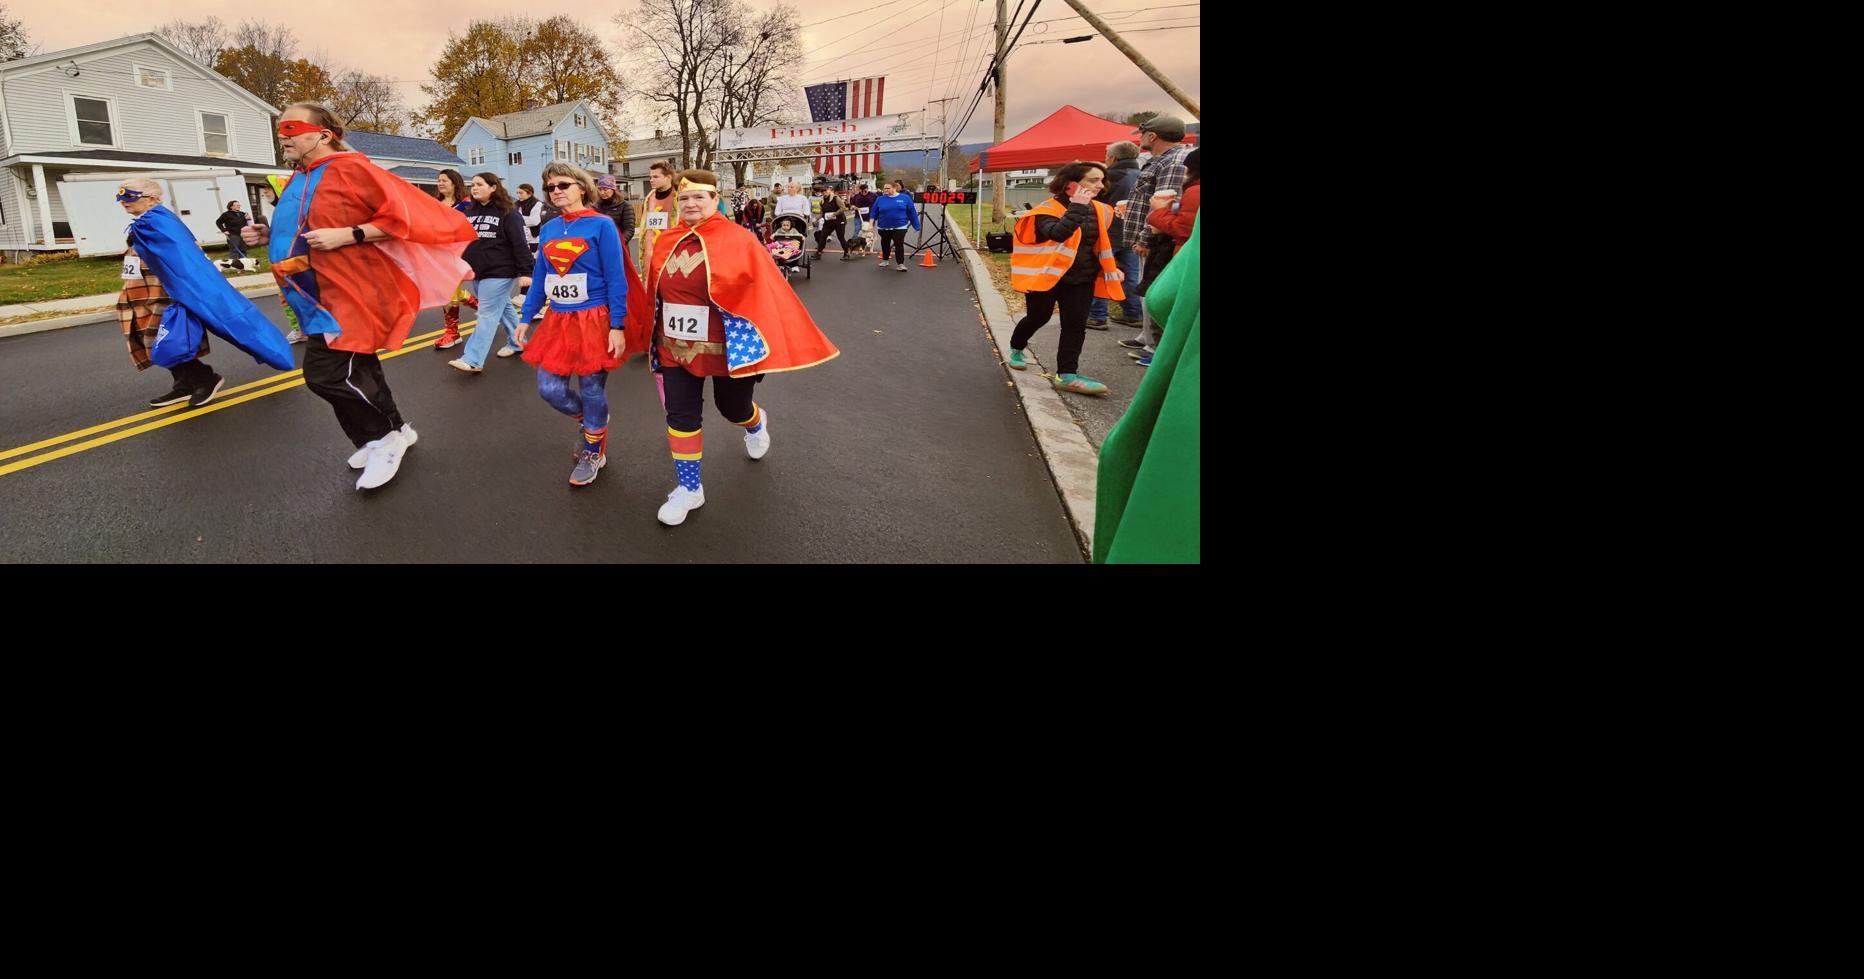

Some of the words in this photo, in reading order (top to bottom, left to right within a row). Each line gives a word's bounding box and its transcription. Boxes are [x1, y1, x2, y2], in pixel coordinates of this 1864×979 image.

[770, 121, 857, 139] Finish
[552, 285, 579, 298] 483
[668, 316, 698, 334] 412
